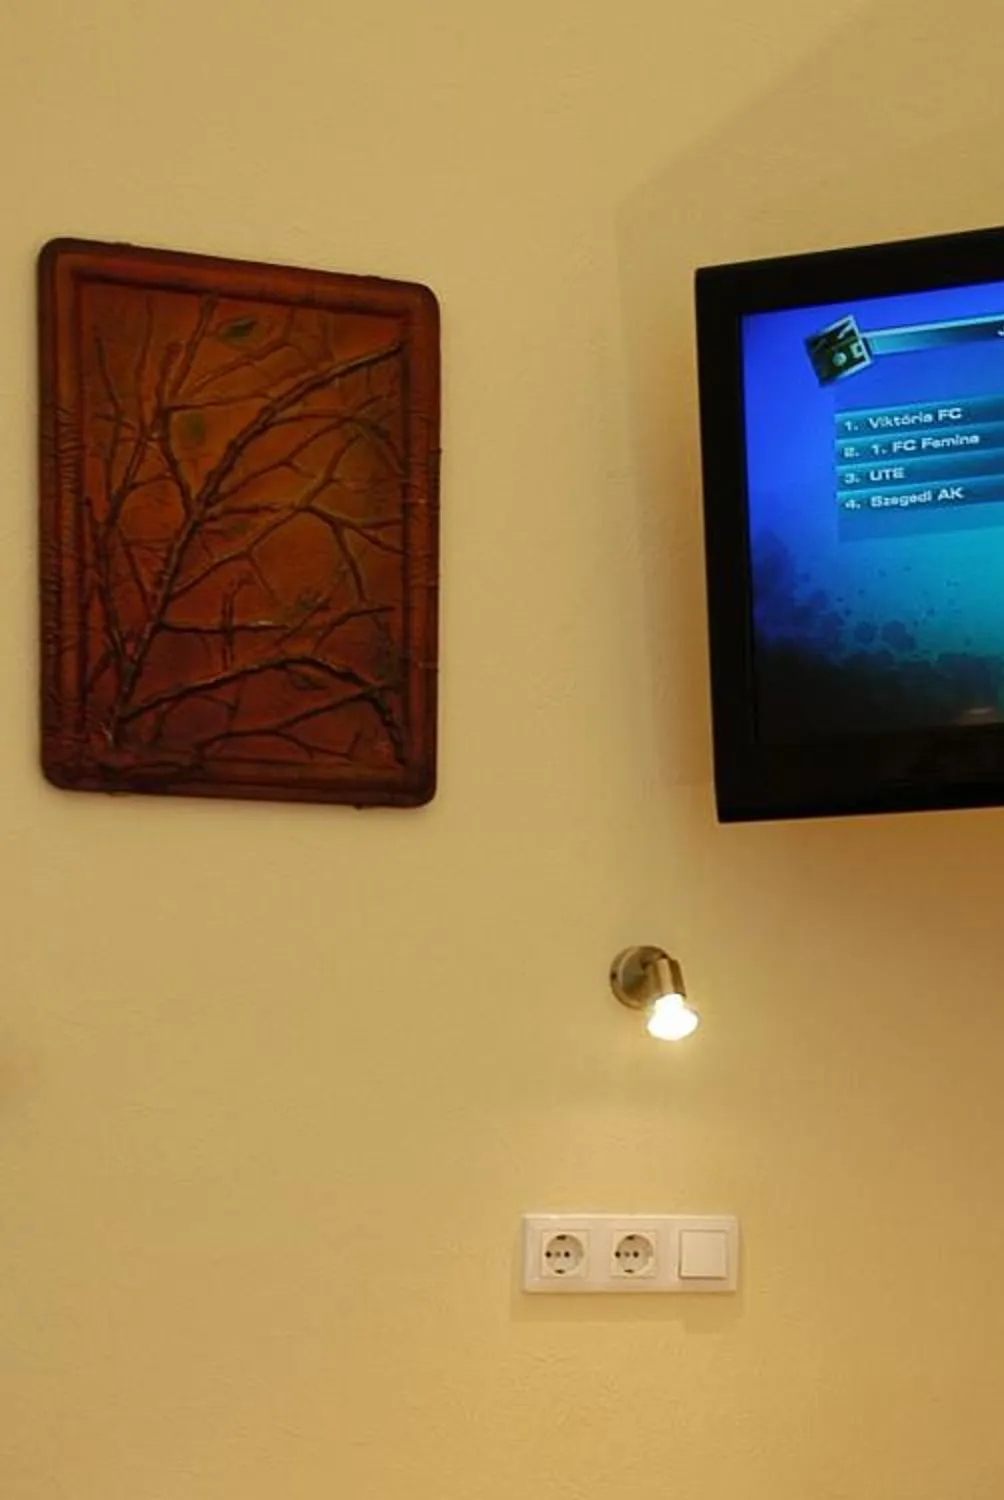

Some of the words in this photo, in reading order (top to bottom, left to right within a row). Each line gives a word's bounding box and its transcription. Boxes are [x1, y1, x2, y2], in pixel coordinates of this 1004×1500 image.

[845, 420, 859, 431] 1.
[868, 411, 933, 429] Viktória
[937, 407, 963, 421] FC
[872, 444, 888, 456] 1.
[892, 440, 917, 453] FC
[921, 434, 981, 449] Femina
[844, 473, 860, 484] 3.
[869, 467, 905, 481] UTE
[845, 500, 861, 510] 4.
[870, 490, 933, 507] Szegedi
[937, 487, 965, 501] AK
